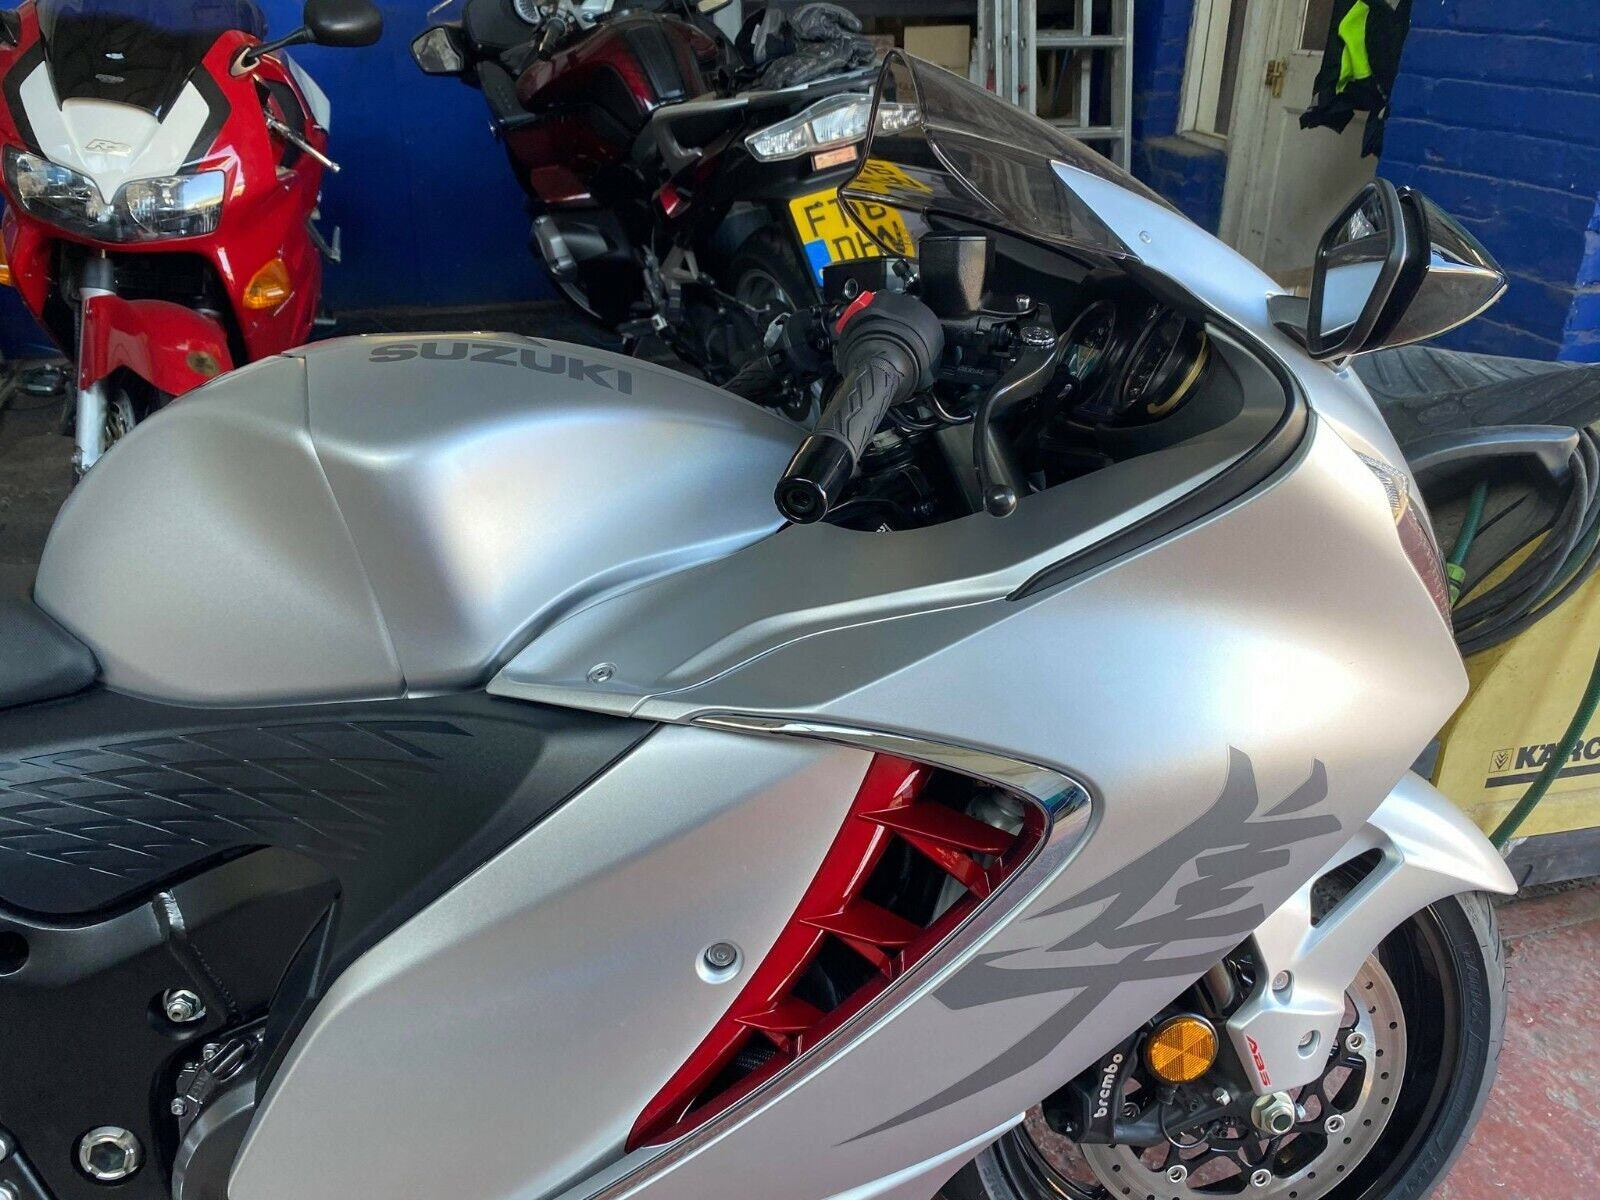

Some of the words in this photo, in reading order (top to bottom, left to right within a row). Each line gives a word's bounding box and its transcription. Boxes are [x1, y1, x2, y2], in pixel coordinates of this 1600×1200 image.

[368, 343, 632, 395] SUZUKI
[1093, 1052, 1124, 1119] brembo
[1246, 1034, 1271, 1086] ABS
